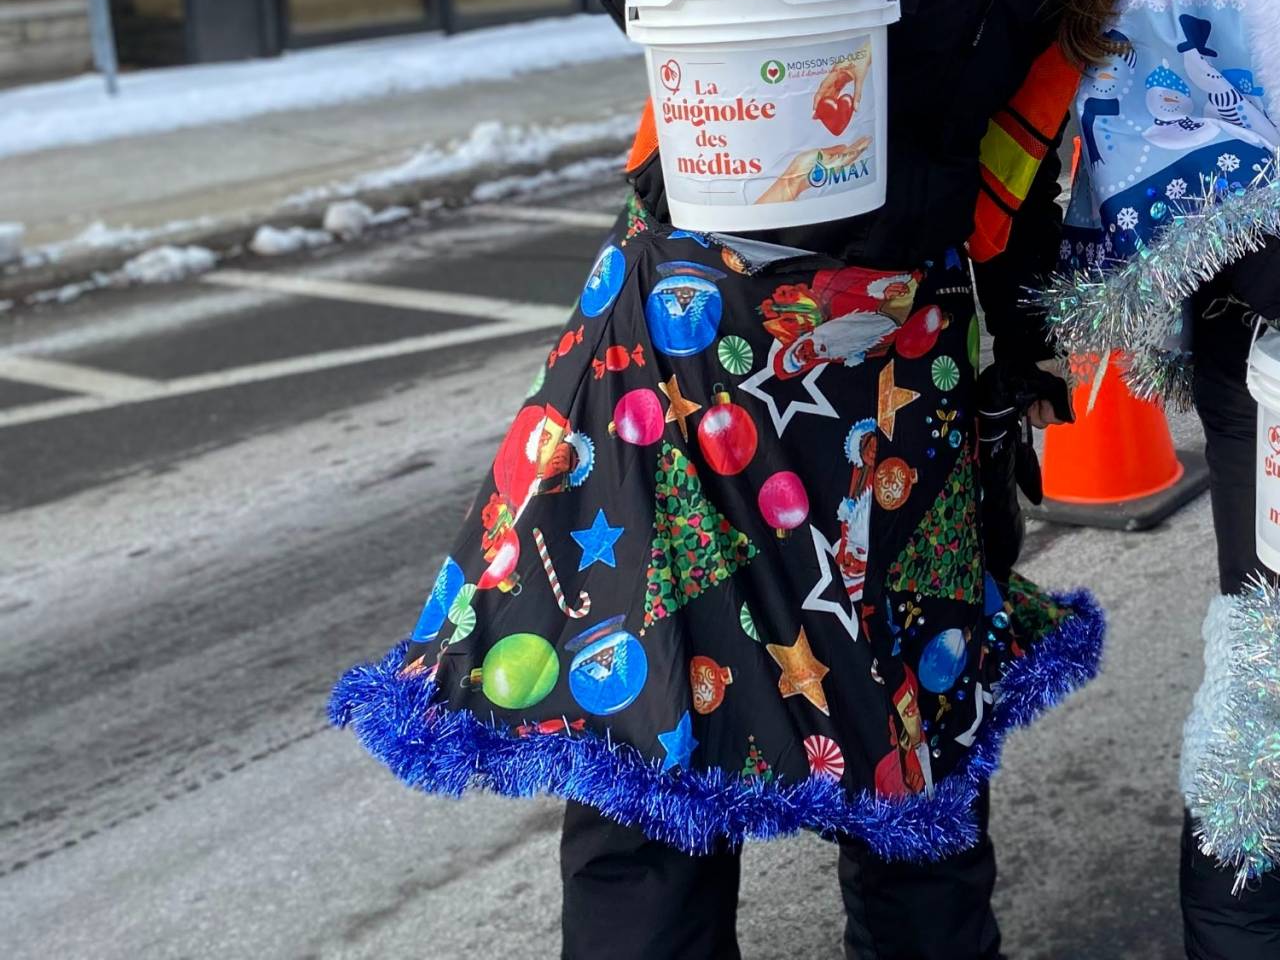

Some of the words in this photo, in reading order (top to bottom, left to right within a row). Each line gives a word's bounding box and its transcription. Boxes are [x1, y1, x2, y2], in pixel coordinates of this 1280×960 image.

[786, 58, 828, 71] MOISSON
[694, 79, 718, 96] La
[662, 96, 776, 127] guignolée
[695, 130, 727, 148] des
[677, 152, 762, 176] médias
